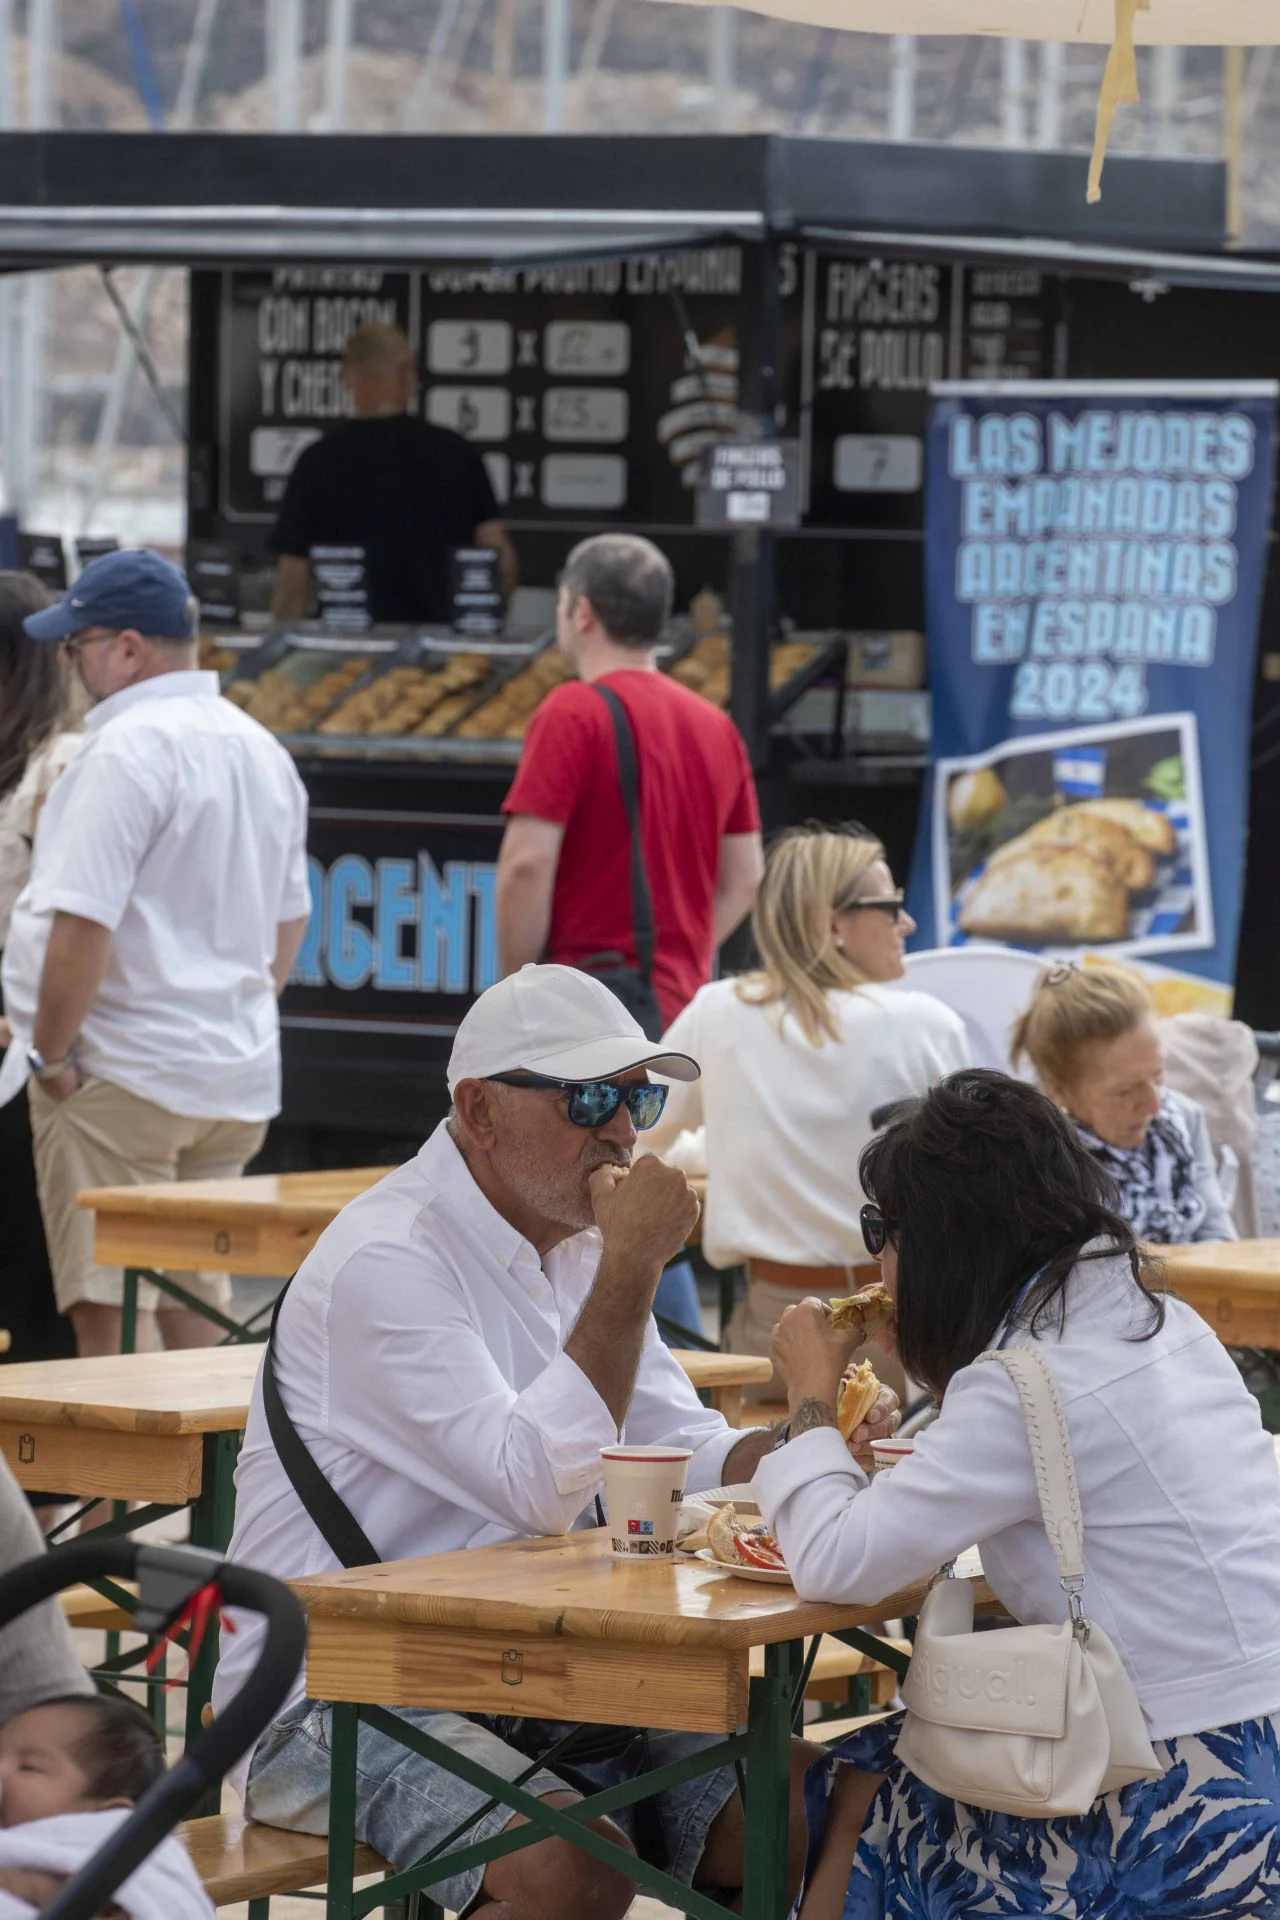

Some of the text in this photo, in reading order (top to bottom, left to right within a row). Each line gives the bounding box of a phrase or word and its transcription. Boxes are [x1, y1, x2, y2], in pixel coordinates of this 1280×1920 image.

[862, 441, 890, 484] 7
[964, 478, 1236, 539] EMPANADAS
[958, 541, 1236, 602] ARGENTINAS
[1011, 661, 1145, 718] 2024
